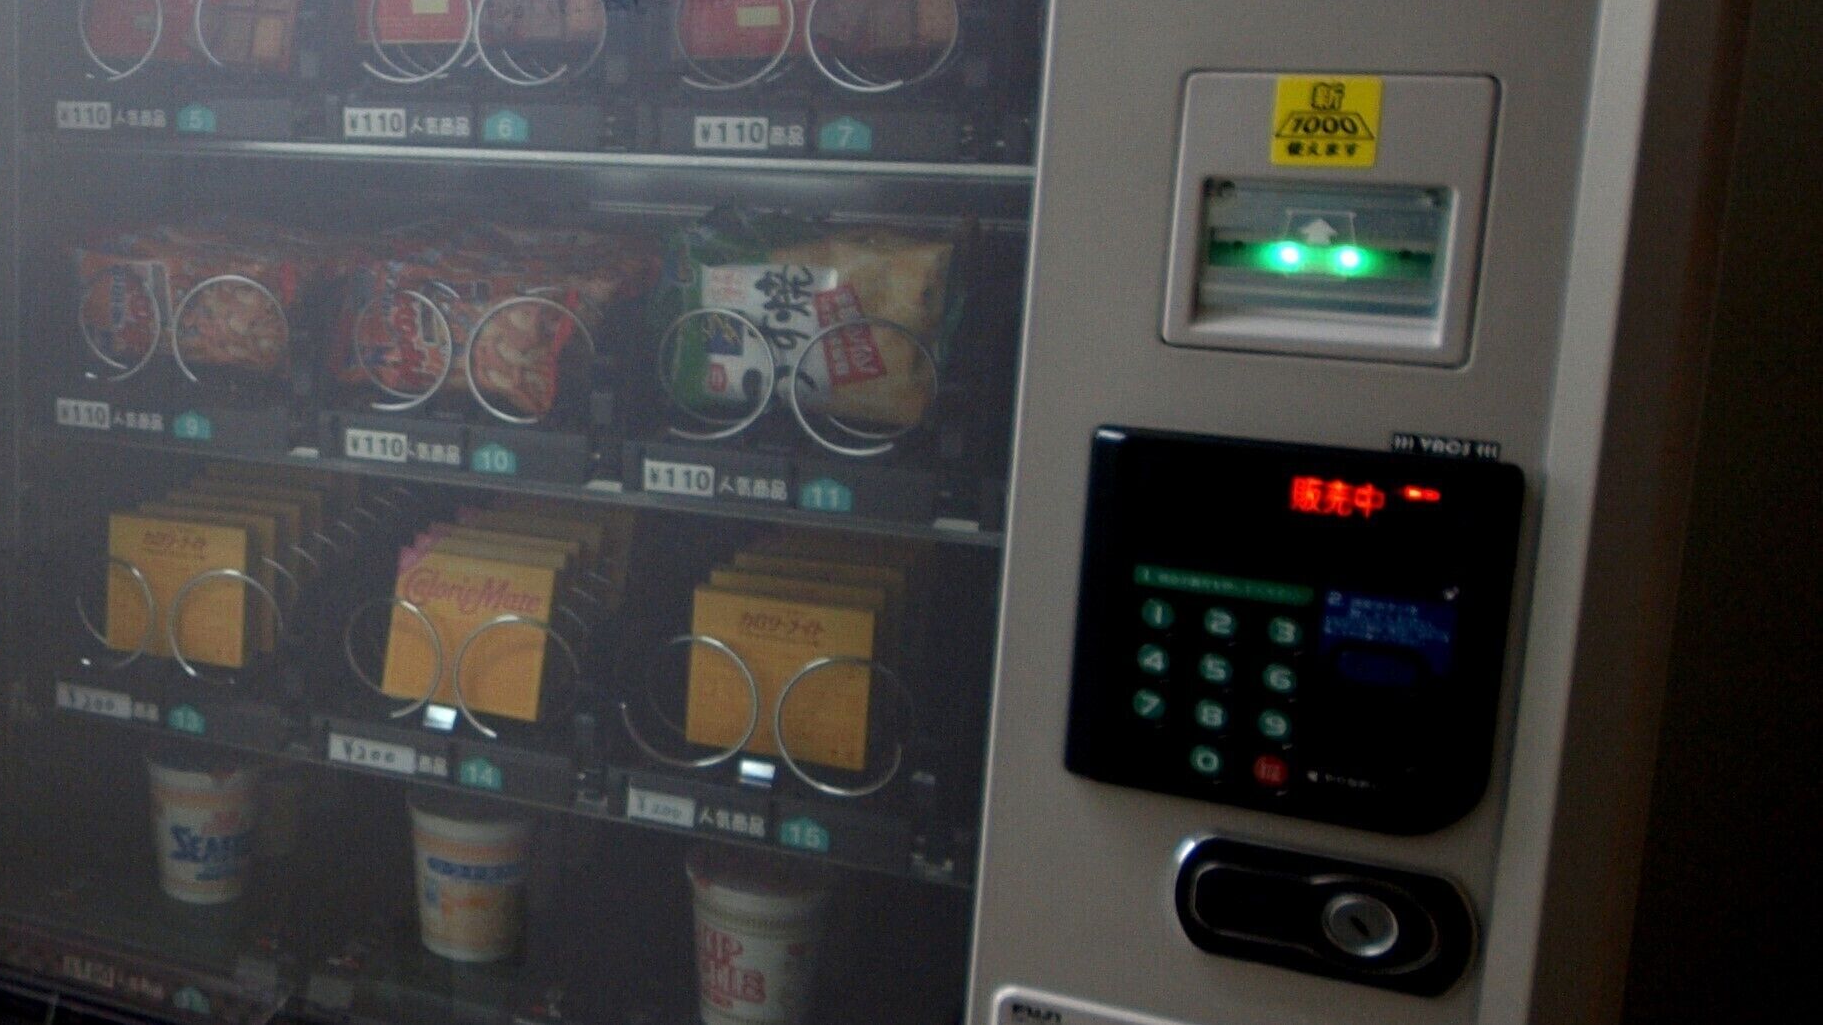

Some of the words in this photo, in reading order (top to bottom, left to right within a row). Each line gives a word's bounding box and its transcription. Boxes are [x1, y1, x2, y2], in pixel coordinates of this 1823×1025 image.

[348, 110, 403, 133] ¥110
[1292, 116, 1357, 134] 1000
[699, 122, 763, 145] ¥110
[349, 433, 404, 459] ¥110
[650, 467, 711, 491] ¥110
[1290, 474, 1387, 518] 販売中
